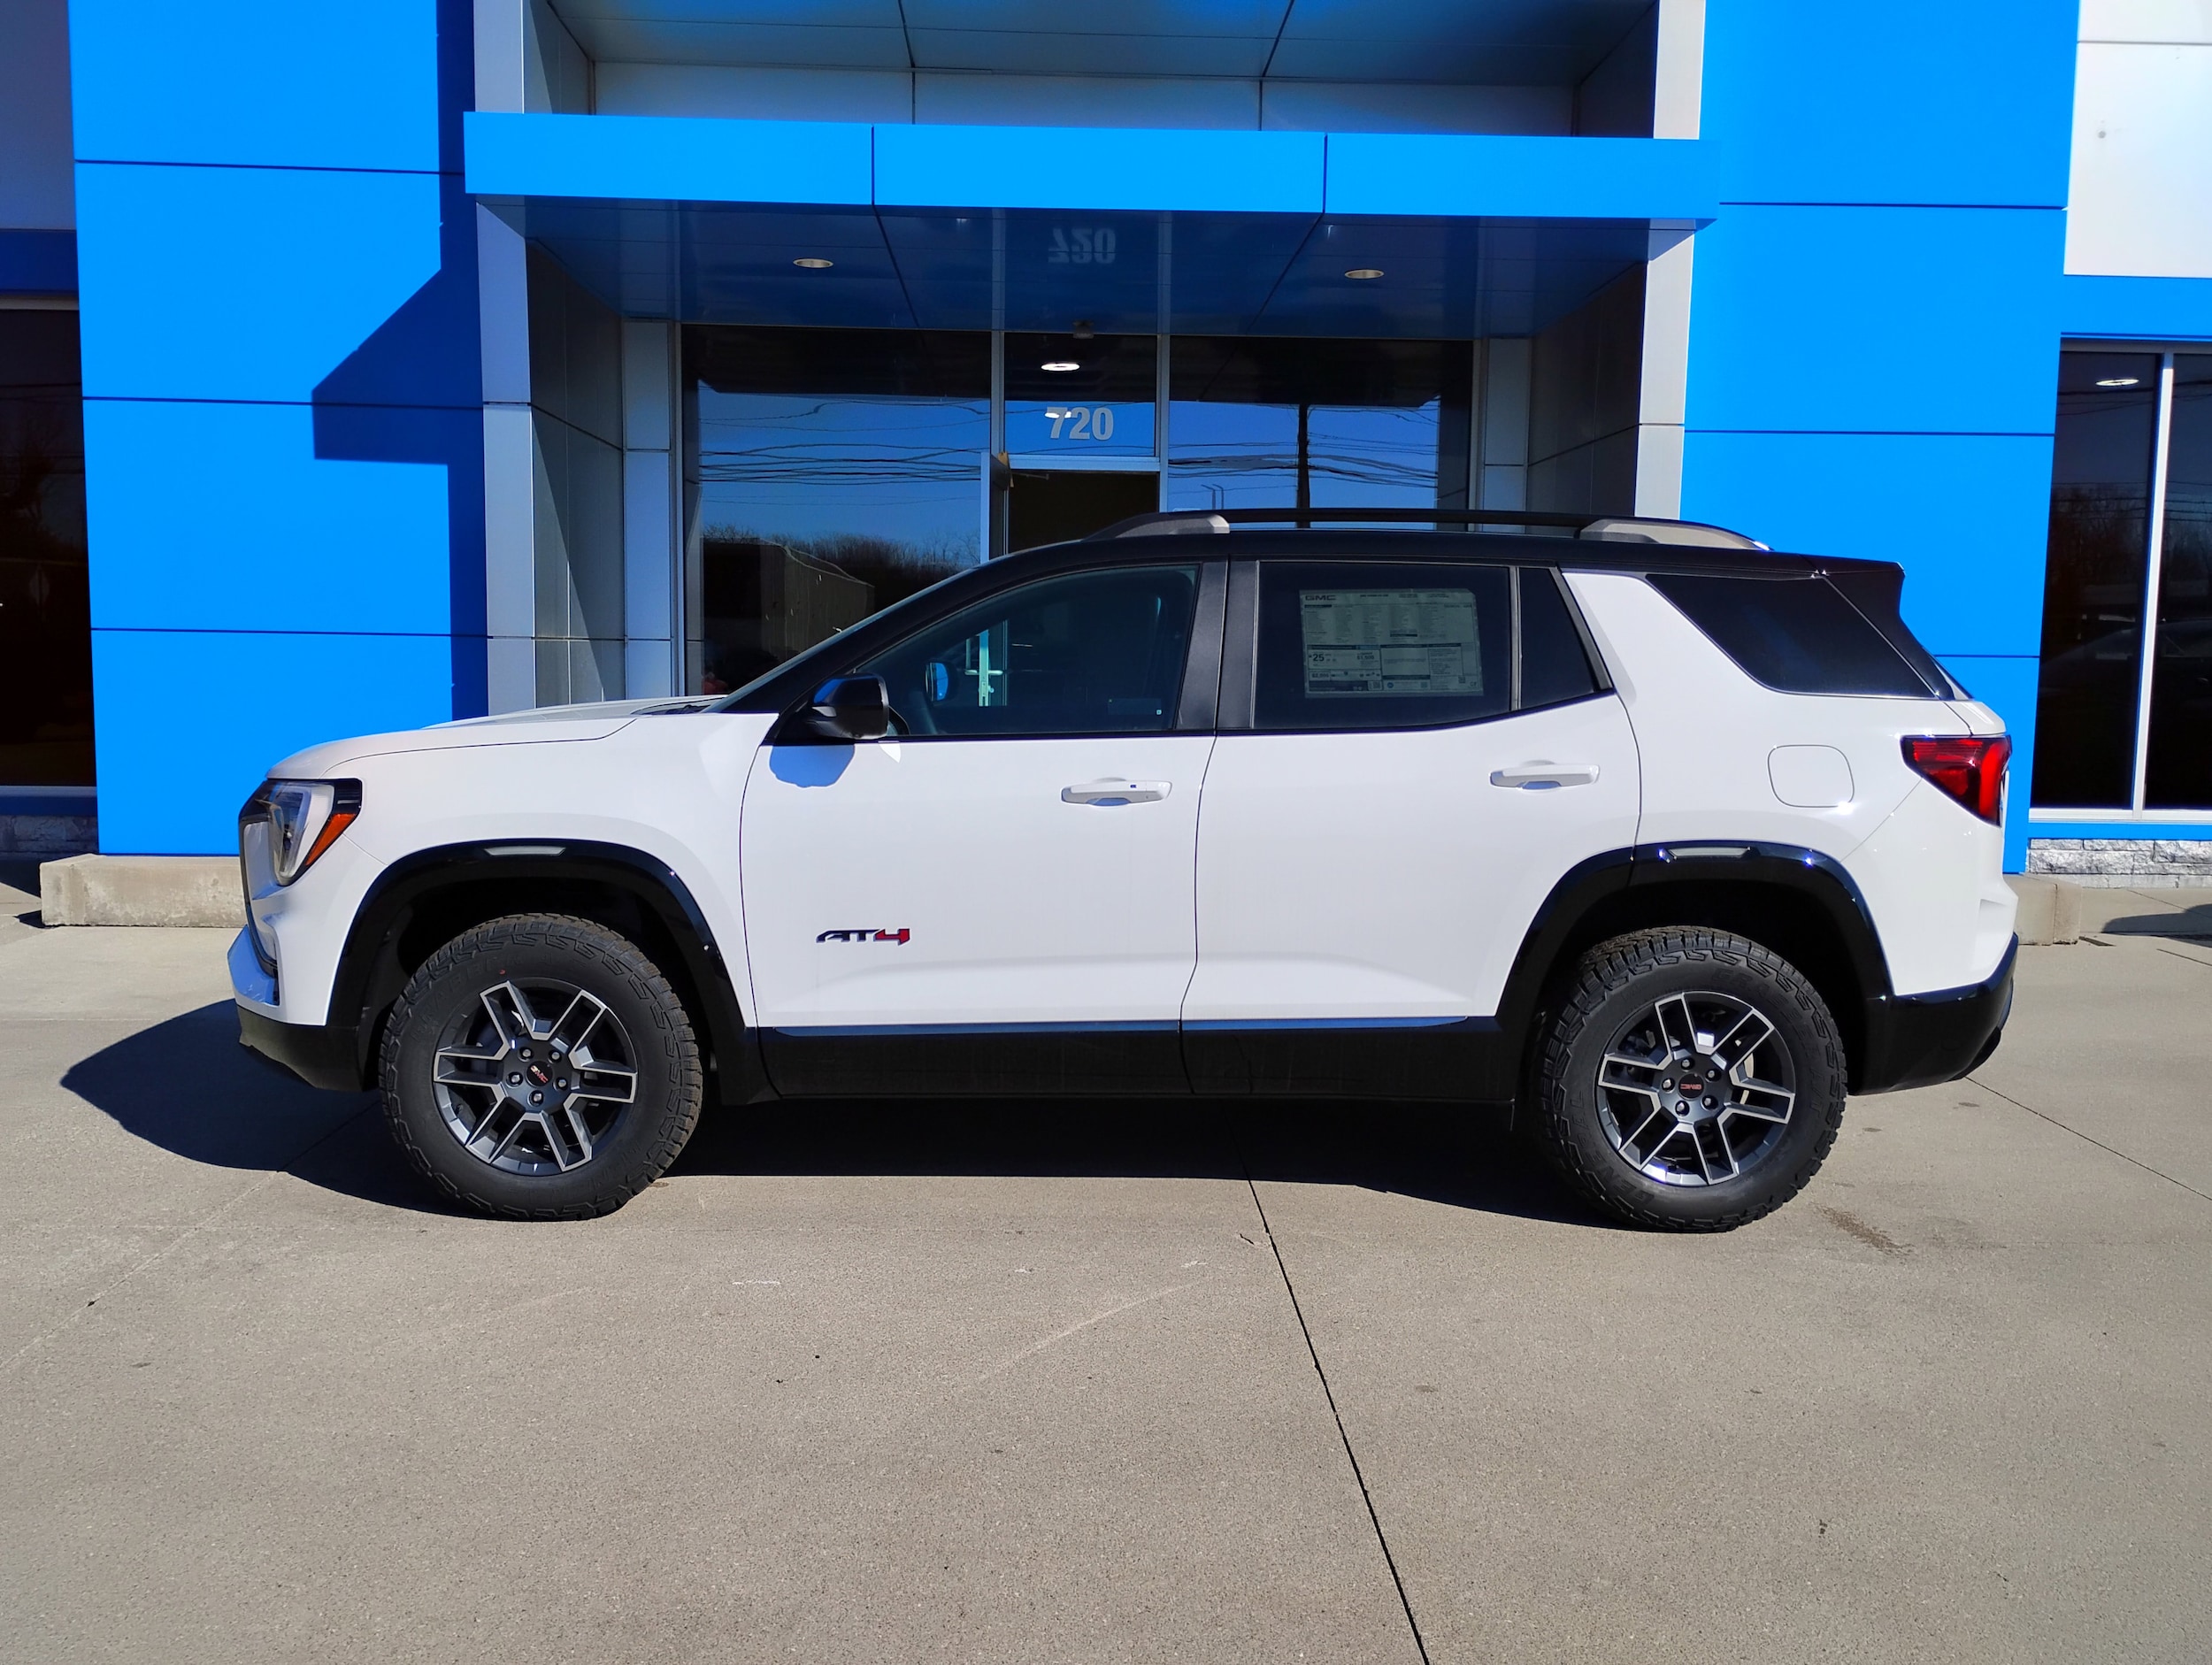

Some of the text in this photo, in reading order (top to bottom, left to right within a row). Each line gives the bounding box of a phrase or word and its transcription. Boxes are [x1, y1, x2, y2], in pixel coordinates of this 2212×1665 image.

[1047, 406, 1114, 441] 720
[1312, 653, 1325, 662] 25
[816, 927, 910, 947] AT4
